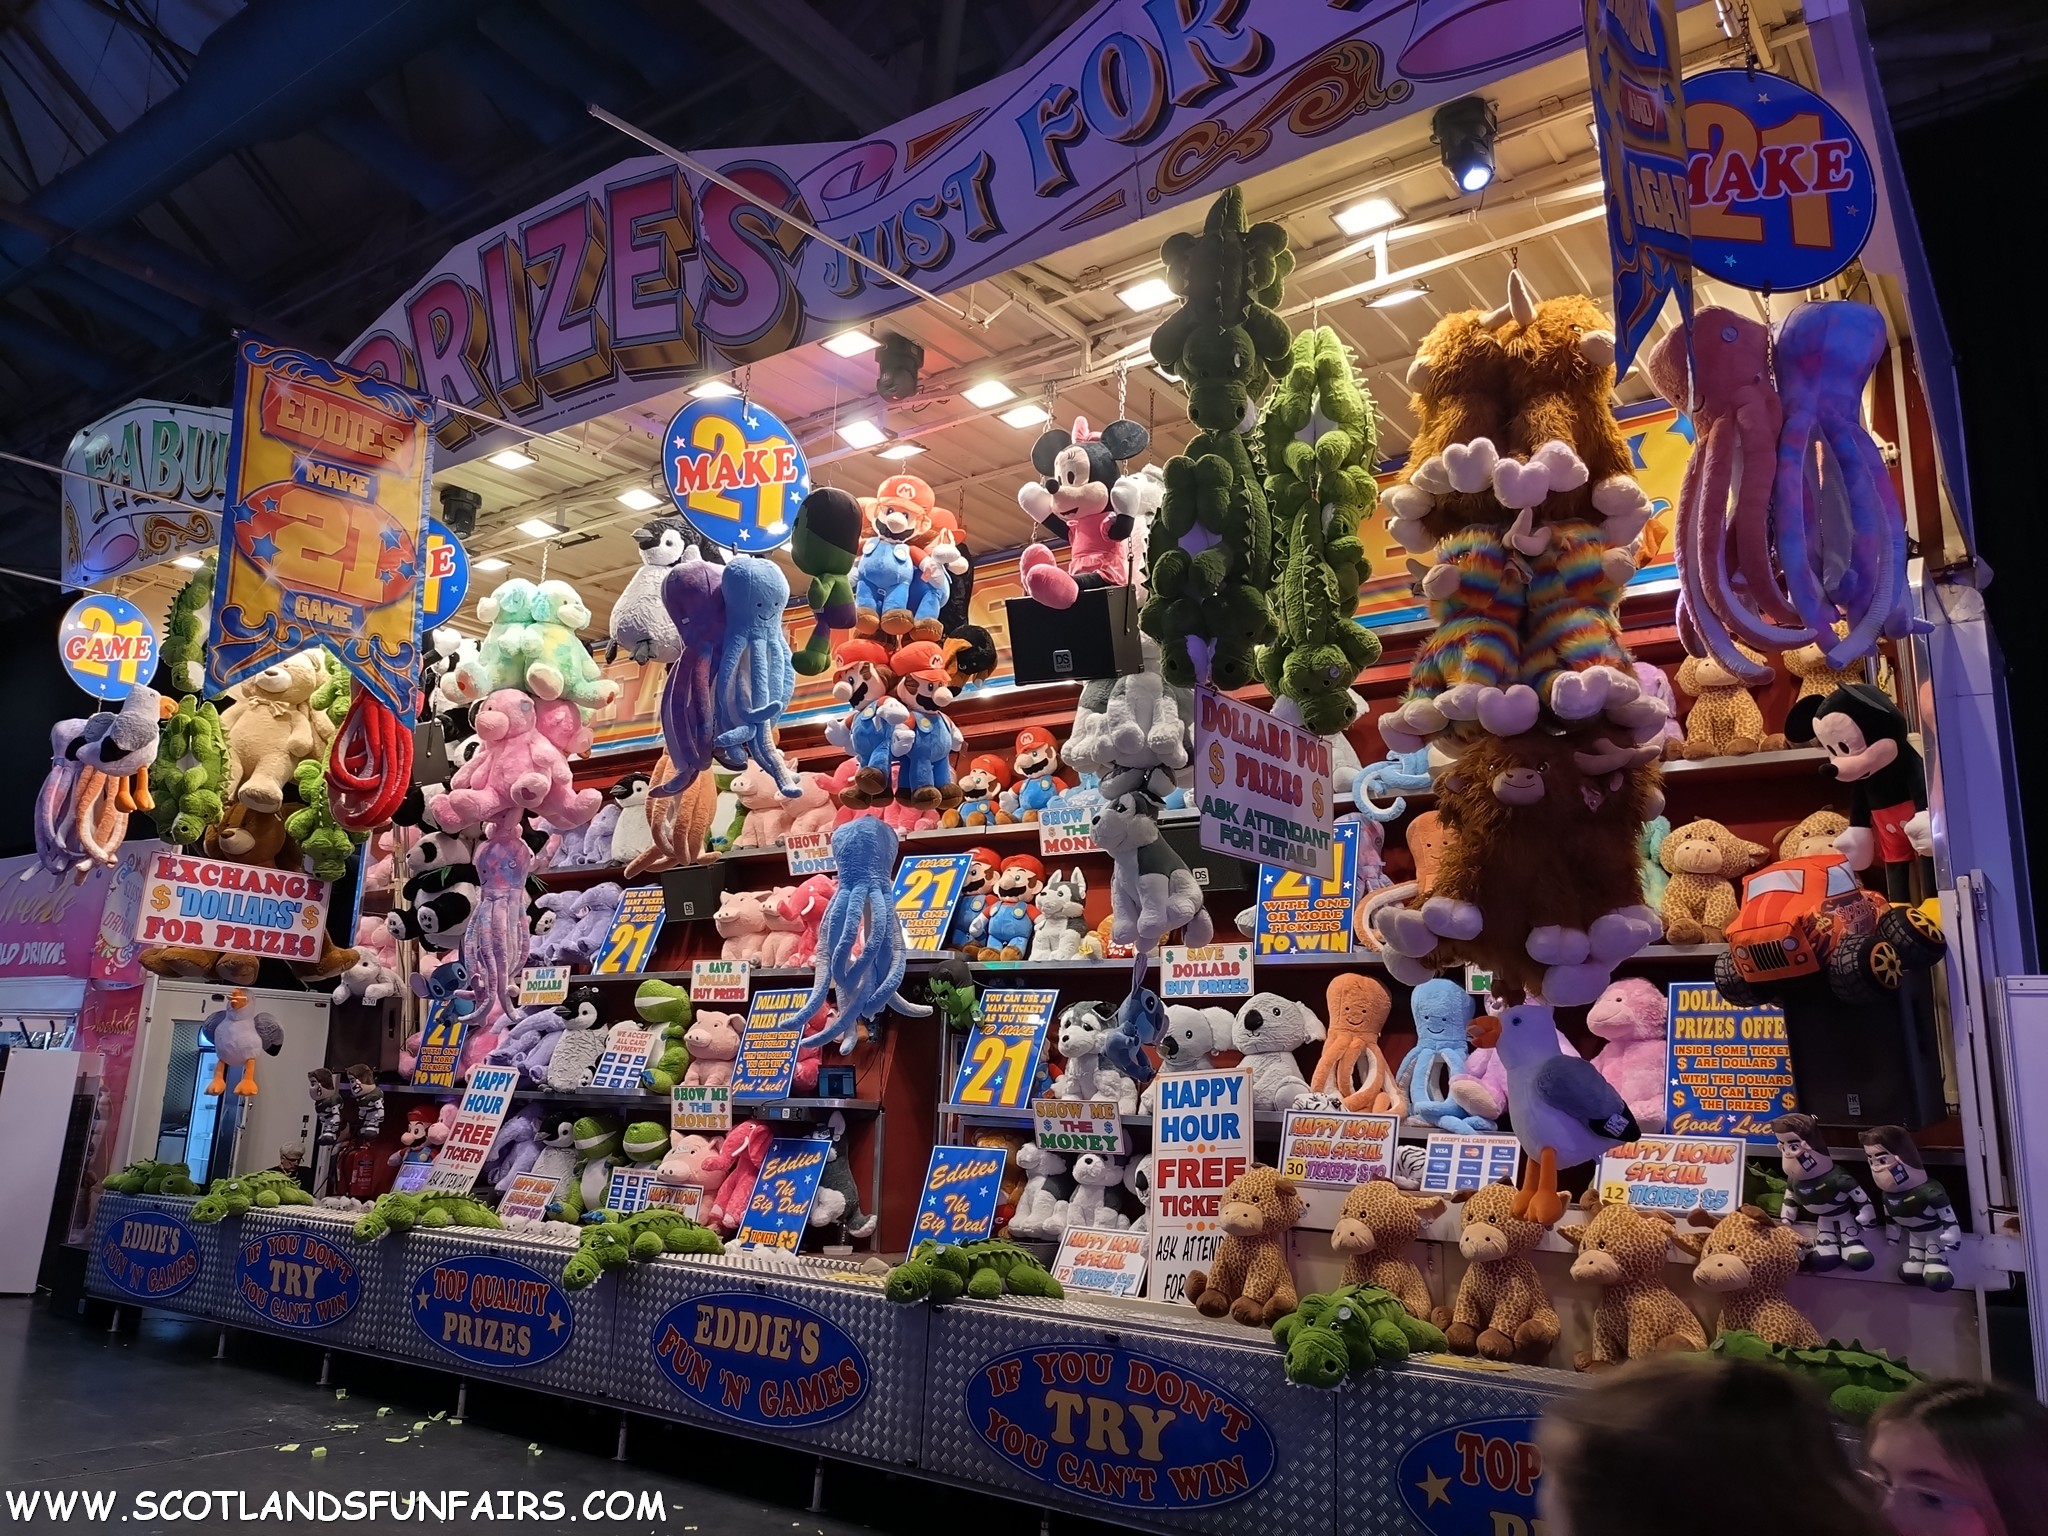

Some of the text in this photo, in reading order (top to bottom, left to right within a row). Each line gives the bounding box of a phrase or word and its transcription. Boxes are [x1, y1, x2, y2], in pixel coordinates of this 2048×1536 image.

[1016, 0, 1274, 198] FOR
[1628, 90, 1654, 127] AND
[1686, 100, 1834, 250] 21
[823, 149, 1005, 301] JUST
[276, 393, 404, 461] EDDIES
[305, 464, 370, 499] MAKE
[675, 444, 798, 496] MAKE
[687, 414, 788, 530] 21
[273, 488, 384, 603] 21
[294, 595, 353, 629] GAME
[64, 635, 152, 661] GAME
[72, 606, 143, 684] 21
[1055, 654, 1070, 664] DS
[1201, 694, 1330, 779] DOLLARS FOR
[1235, 752, 1303, 807] PRIZES
[1042, 809, 1084, 825] SHOW
[1201, 795, 1330, 850] ASK ATTENDANT
[788, 835, 820, 849] SHOW
[1220, 823, 1254, 852] FOR
[805, 847, 828, 858] THE
[154, 857, 324, 901] EXCHANGE
[1194, 870, 1207, 880] DS
[895, 868, 958, 910] 21
[922, 910, 949, 918] ONE
[1262, 898, 1351, 911] WITH ONE
[1266, 909, 1343, 921] OR MORE
[906, 919, 941, 927] MORE
[1269, 920, 1341, 933] TICKETS
[143, 916, 317, 958] FOR PRIZES
[599, 923, 655, 973] 21
[1259, 931, 1348, 953] TO WIN
[1187, 946, 1224, 961] SAVE
[709, 962, 732, 973] SAVE
[1172, 961, 1240, 978] DOLLARS
[698, 975, 741, 986] DOLLARS
[1165, 978, 1249, 995] BUY PRIZES
[693, 988, 712, 999] BUY
[755, 995, 789, 1010] DOLLARS
[985, 993, 1053, 1003] YOU CAN USE AS
[985, 1004, 1045, 1013] MANY TICKETS
[985, 1014, 1014, 1023] AS YOU
[748, 1013, 777, 1029] PRIZES
[980, 1024, 1038, 1036] TO MAKE
[1675, 1017, 1735, 1040] PRIZES
[613, 1045, 645, 1053] PAYMENTS
[1673, 1045, 1748, 1056] INSIDE SOME
[960, 1036, 1033, 1106] 21
[1694, 1057, 1777, 1069] ARE DOLLARS
[414, 1070, 454, 1087] TO WIN
[472, 1070, 516, 1092] HAPPY
[732, 1079, 755, 1095] Good
[1679, 1073, 1793, 1086] WITH THE DOLLARS
[673, 1087, 728, 1101] SHOW ME
[1161, 1076, 1243, 1109] HAPPY
[1691, 1086, 1746, 1098] YOU CAN
[463, 1094, 504, 1115] HOUR
[689, 1103, 712, 1113] THE
[1036, 1102, 1116, 1119] SHOW ME
[1700, 1099, 1770, 1111] THE PRIZES
[673, 1114, 728, 1128] MONEY
[1060, 1120, 1093, 1133] THE
[1161, 1112, 1241, 1143] HOUR
[1288, 1117, 1392, 1141] HAPPY HOUR
[1672, 1112, 1724, 1136] Good
[450, 1121, 496, 1146] FREE
[1039, 1132, 1118, 1151] MONEY
[443, 1145, 484, 1164] TICKETS
[1290, 1139, 1383, 1161] EXTRA SPECIAL
[1606, 1141, 1738, 1164] HAPPY HOUR
[762, 1151, 822, 1180] Eddies
[928, 1159, 998, 1190] Eddies
[1157, 1157, 1246, 1189] FREE
[1287, 1161, 1357, 1182] 30 TICKETS
[1625, 1161, 1707, 1185] SPECIAL
[774, 1179, 796, 1197] The
[1604, 1184, 1699, 1209] 12 TICKETS
[751, 1194, 810, 1216] Big Deal
[944, 1193, 970, 1215] The
[918, 1212, 989, 1237] Big Deal
[120, 1220, 181, 1256] EDDIE'S
[739, 1226, 798, 1249] 5 TICKETS £3
[1066, 1231, 1112, 1250] HAPPY
[1156, 1236, 1177, 1261] ASK
[103, 1236, 197, 1292] FUN GAMES
[245, 1235, 352, 1285] IF YOU DON'T
[1073, 1250, 1127, 1269] SPECIAL
[269, 1259, 323, 1299] TRY
[1057, 1268, 1117, 1289] 12 TICKETS
[1164, 1274, 1186, 1300] FOR
[240, 1273, 349, 1323] YOU CAN'T WIN
[433, 1267, 550, 1317] TOP QUALITY
[442, 1311, 532, 1357] PRIZES
[694, 1303, 821, 1365] EDDIE'S
[656, 1323, 861, 1419] FUN GAMES
[985, 1352, 1253, 1444] IF YOU DON'T
[1045, 1388, 1177, 1463] TRY
[984, 1405, 1252, 1503] YOU CAN'T WIN
[1455, 1431, 1543, 1497] TOP
